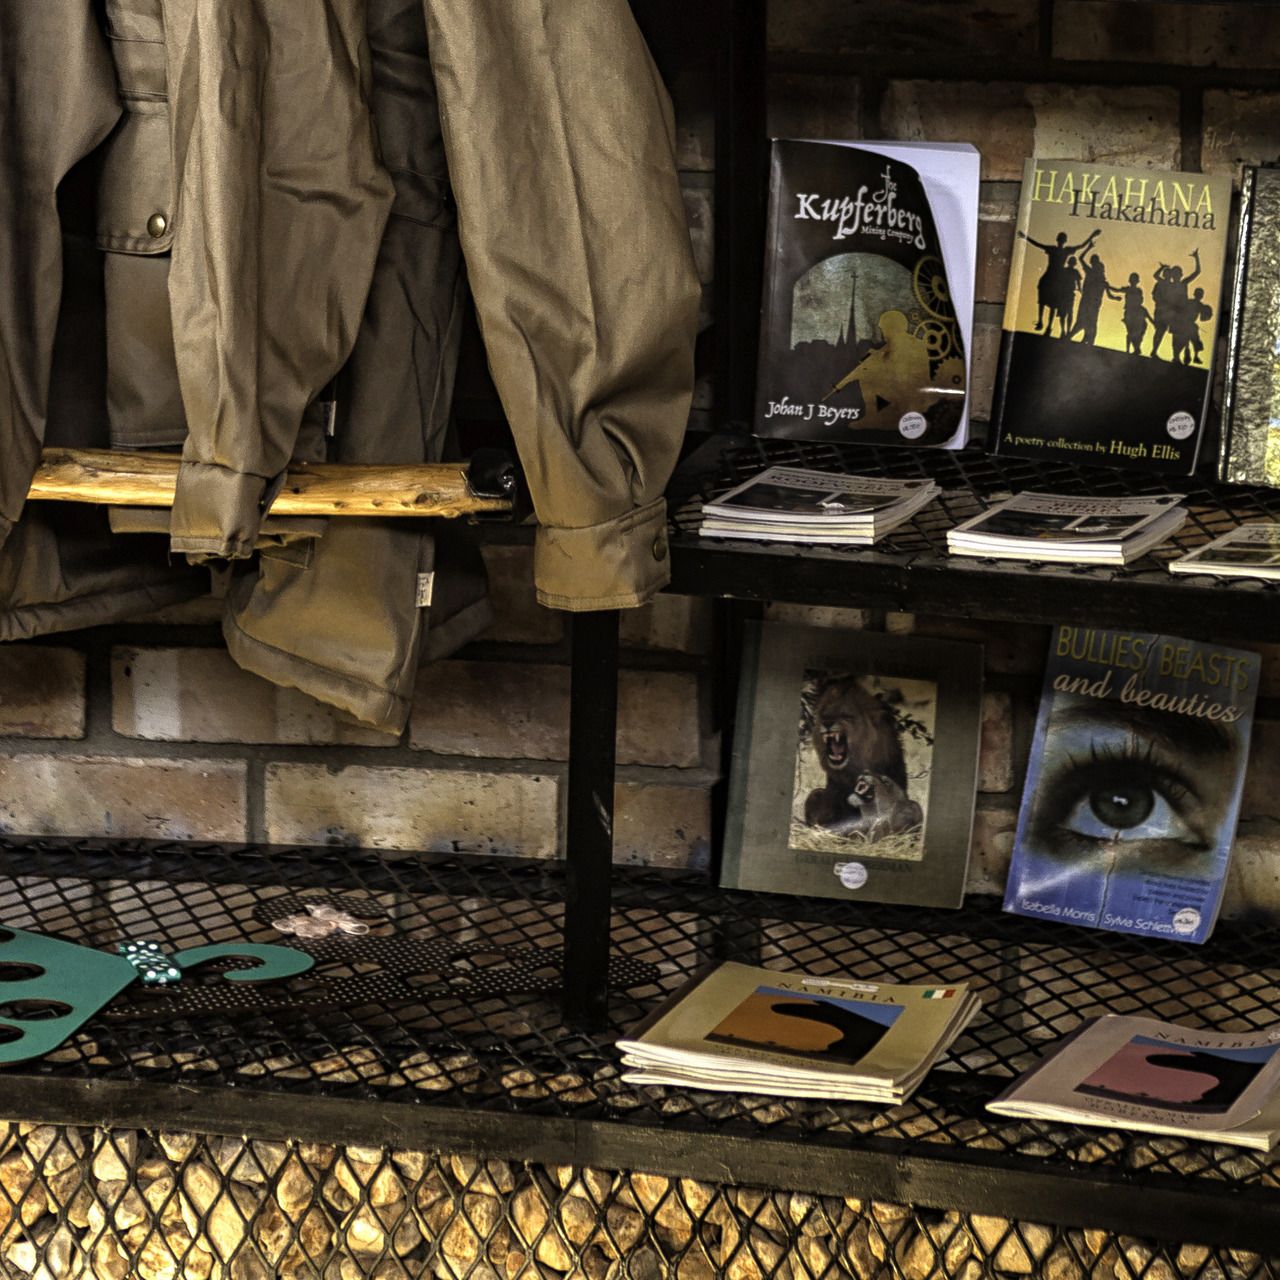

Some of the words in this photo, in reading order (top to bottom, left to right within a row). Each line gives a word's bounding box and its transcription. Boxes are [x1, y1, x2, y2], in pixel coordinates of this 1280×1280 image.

[1032, 169, 1212, 214] HAKAHANA
[1069, 189, 1216, 230] Hakahana
[794, 185, 926, 250] Kupferberg
[860, 225, 886, 240] Mining
[887, 228, 914, 244] Company
[764, 396, 804, 419] Johan
[803, 404, 815, 420] J
[817, 405, 860, 426] Beyers
[1004, 433, 1013, 443] A
[1015, 435, 1044, 448] poetry
[1047, 437, 1093, 452] collection
[1096, 441, 1108, 453] by
[1110, 440, 1147, 459] Hugh
[1152, 444, 1181, 460] Ellis
[1159, 644, 1251, 691] BEASTS
[1053, 670, 1112, 698] and
[1120, 673, 1245, 722] beauties
[778, 981, 896, 1004] NAMIBIA
